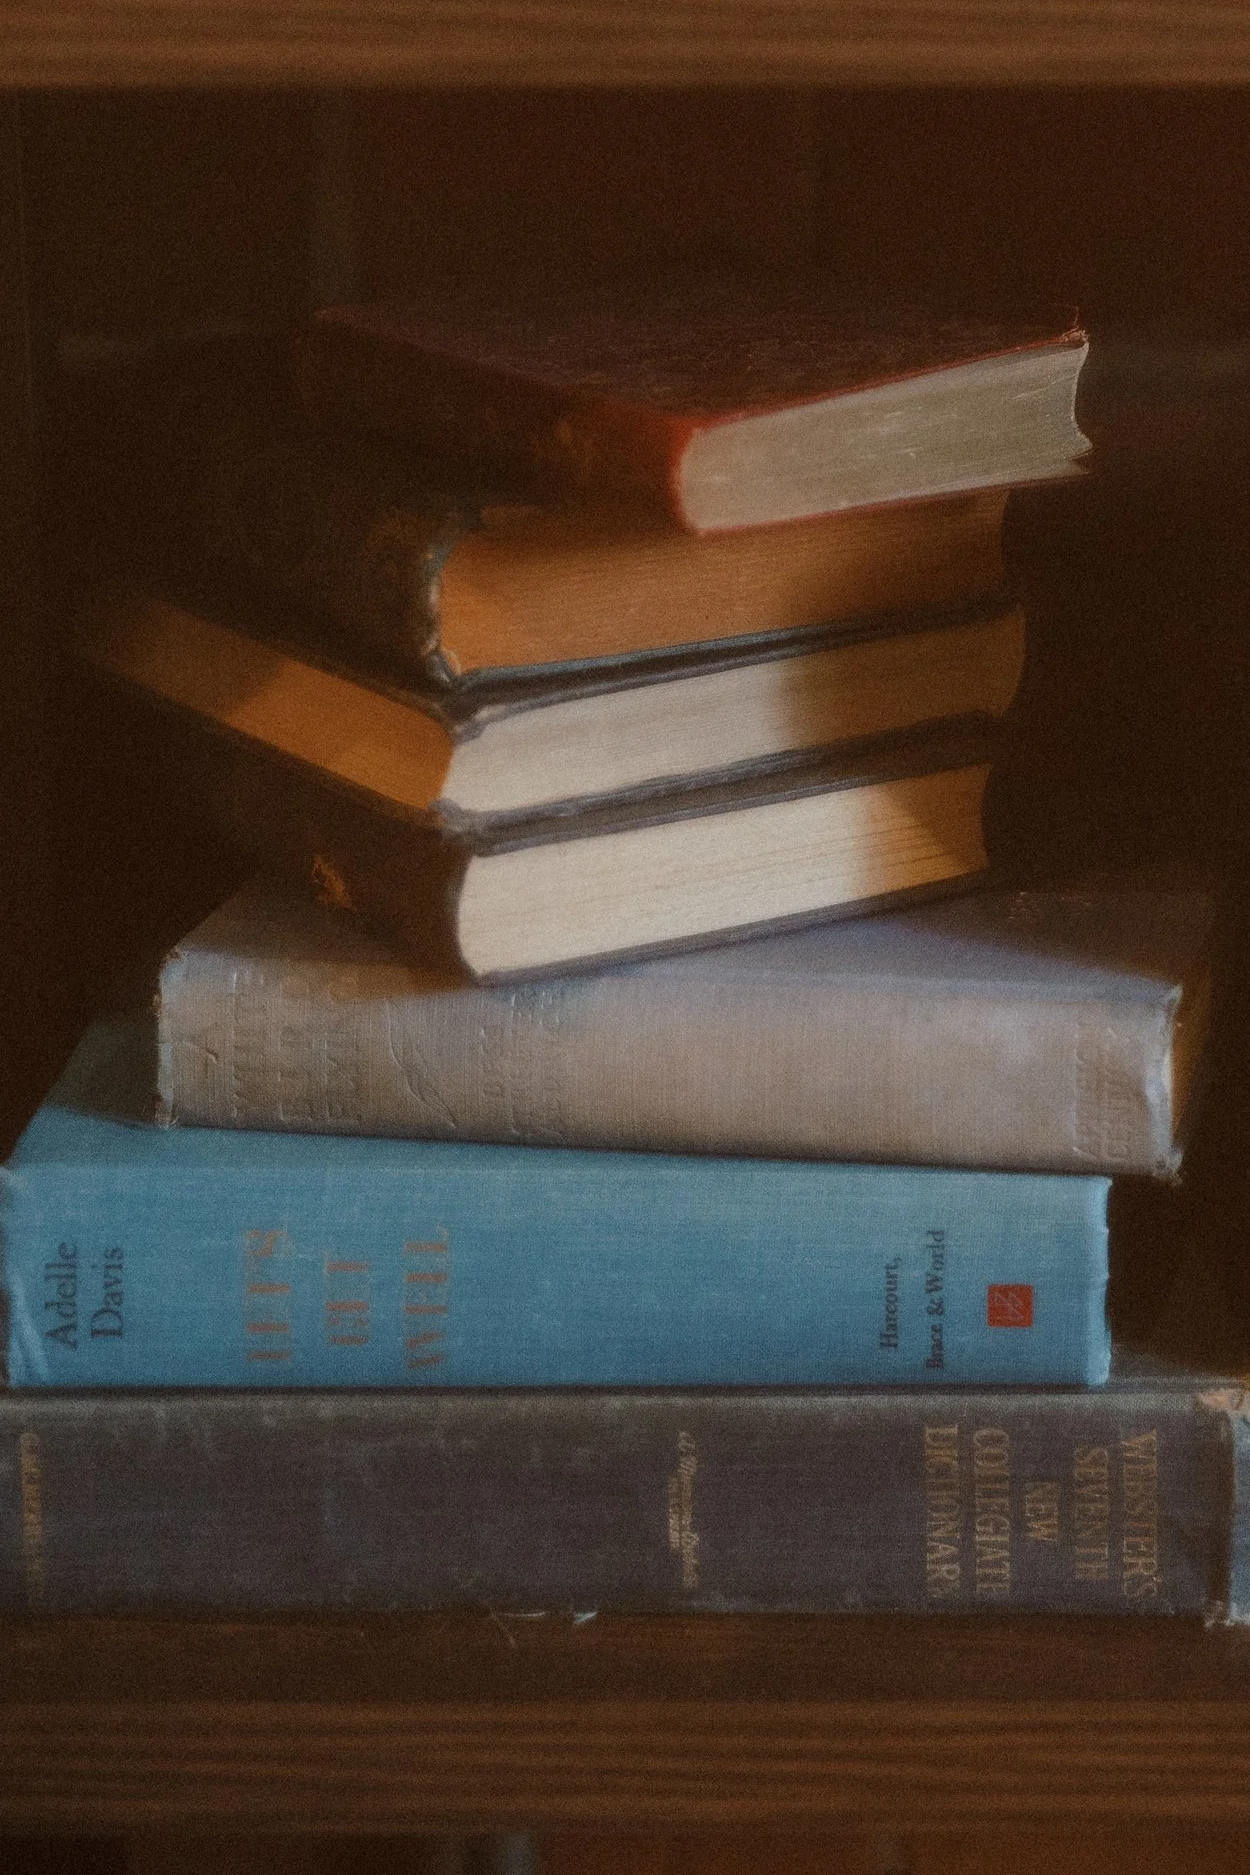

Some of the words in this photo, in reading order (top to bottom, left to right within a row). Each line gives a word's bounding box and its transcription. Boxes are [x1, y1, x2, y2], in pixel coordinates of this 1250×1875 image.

[44, 1240, 79, 1351] Adelle
[90, 1246, 126, 1339] Davis
[879, 1256, 902, 1350] Harcourt,
[924, 1229, 946, 1294] World
[926, 1296, 946, 1317] &
[925, 1325, 945, 1370] Brace
[924, 1424, 962, 1599] DICTIONARY
[972, 1428, 1011, 1597] COLLEGIATE
[1024, 1481, 1061, 1542] NEW
[1073, 1446, 1110, 1581] SEVENTH
[1119, 1428, 1163, 1600] WEBSTER'S
